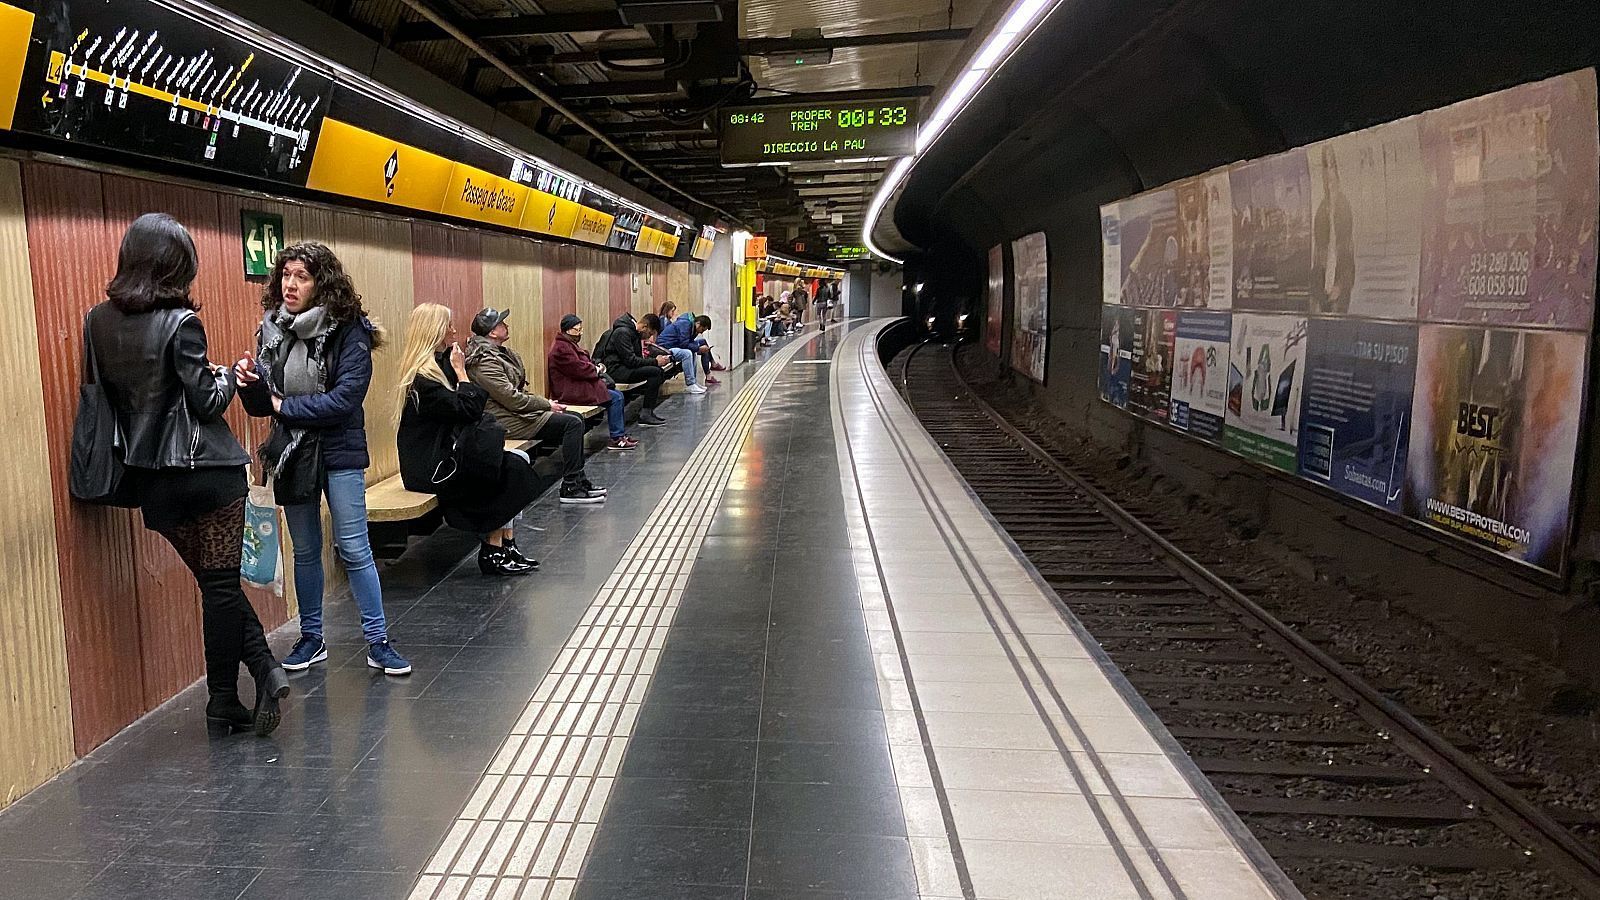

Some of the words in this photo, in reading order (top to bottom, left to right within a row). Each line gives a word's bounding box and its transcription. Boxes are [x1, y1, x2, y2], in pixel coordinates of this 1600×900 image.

[48, 62, 61, 81] L4
[730, 113, 765, 124] 08:42
[790, 109, 832, 121] PROPER
[837, 106, 907, 128] 00:33
[790, 121, 818, 131] TREN
[823, 140, 838, 151] LA
[844, 139, 866, 150] PAU
[461, 178, 489, 211] Passeig
[487, 186, 496, 208] de
[495, 188, 516, 213] Gràcia
[1469, 275, 1486, 296] 608
[1488, 275, 1506, 296] 058
[1508, 275, 1528, 296] 910
[1373, 343, 1384, 361] SU
[1457, 402, 1499, 441] BEST
[1344, 464, 1386, 493] Subastas.com
[1426, 498, 1531, 544] WWW.BESTPROTEIN.COM
